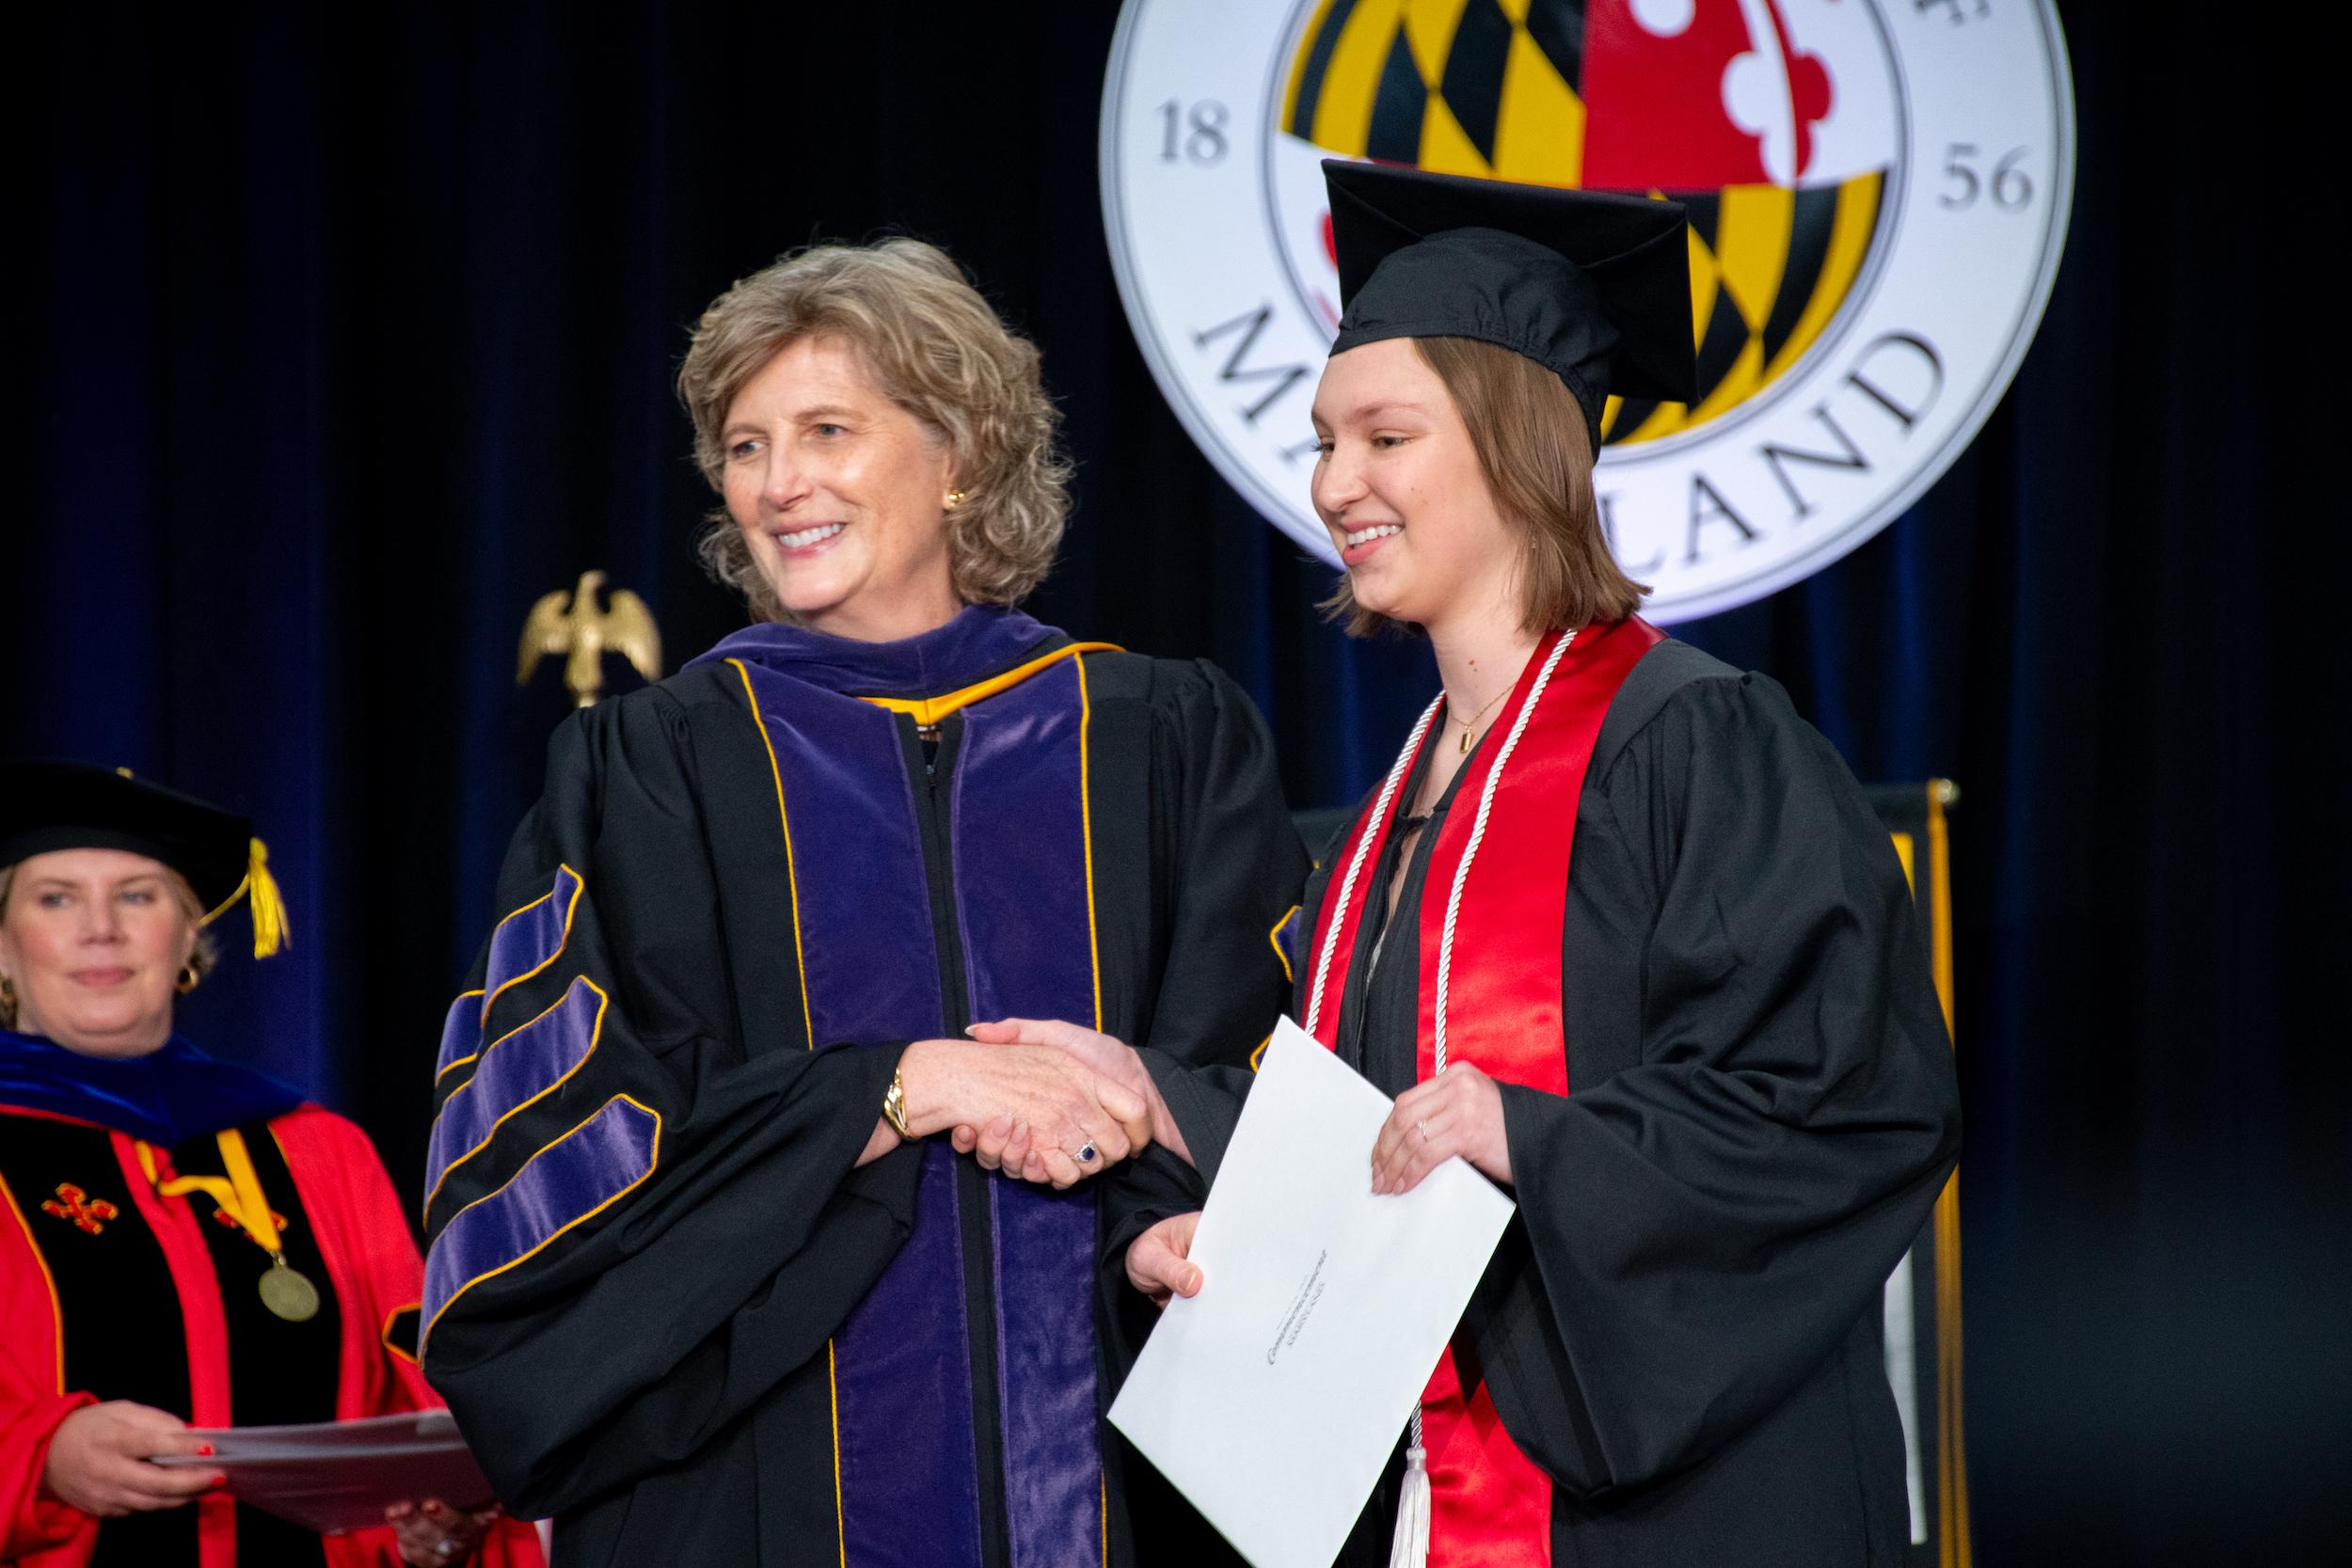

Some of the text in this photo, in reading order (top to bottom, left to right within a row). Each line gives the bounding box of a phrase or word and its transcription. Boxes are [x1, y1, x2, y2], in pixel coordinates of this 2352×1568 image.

[1154, 98, 1230, 167] 18
[1939, 143, 2033, 213] 56
[1192, 304, 1946, 570] MLAND
